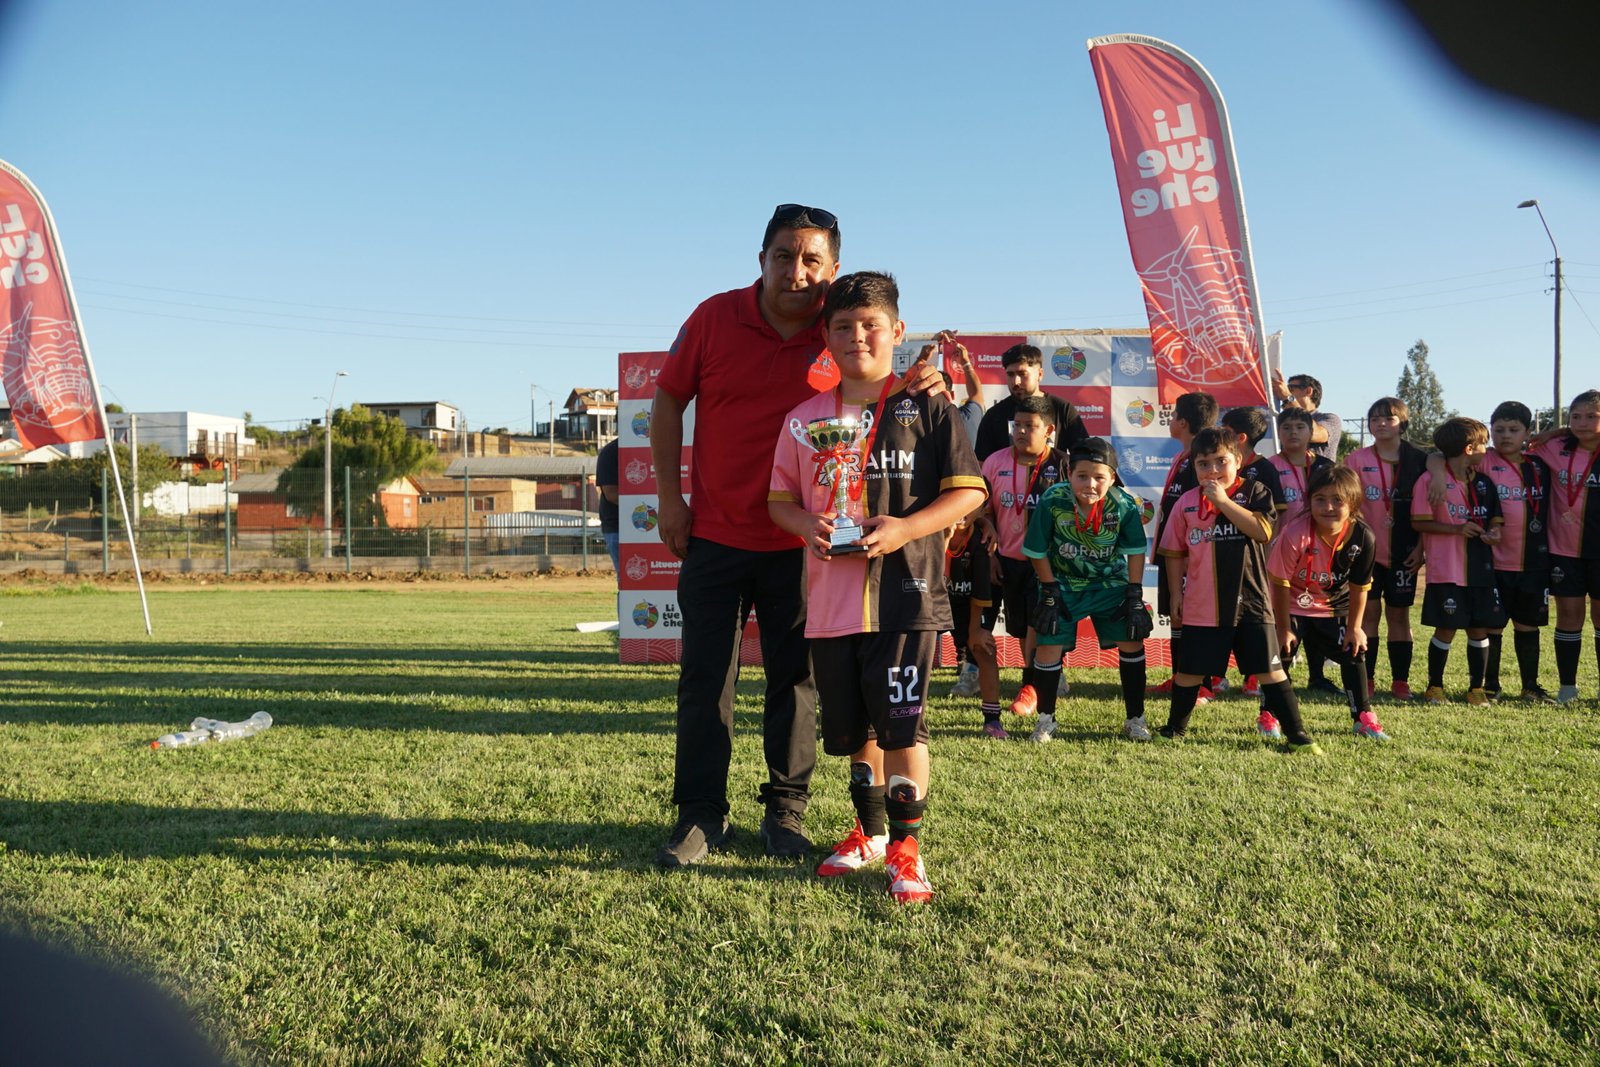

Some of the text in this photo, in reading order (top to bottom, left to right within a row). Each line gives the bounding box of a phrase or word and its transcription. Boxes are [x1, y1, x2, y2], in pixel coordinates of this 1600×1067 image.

[1158, 410, 1172, 419] tu
[844, 449, 916, 472] RAHM
[665, 604, 675, 612] Li
[662, 612, 680, 620] tue
[887, 664, 920, 704] 52
